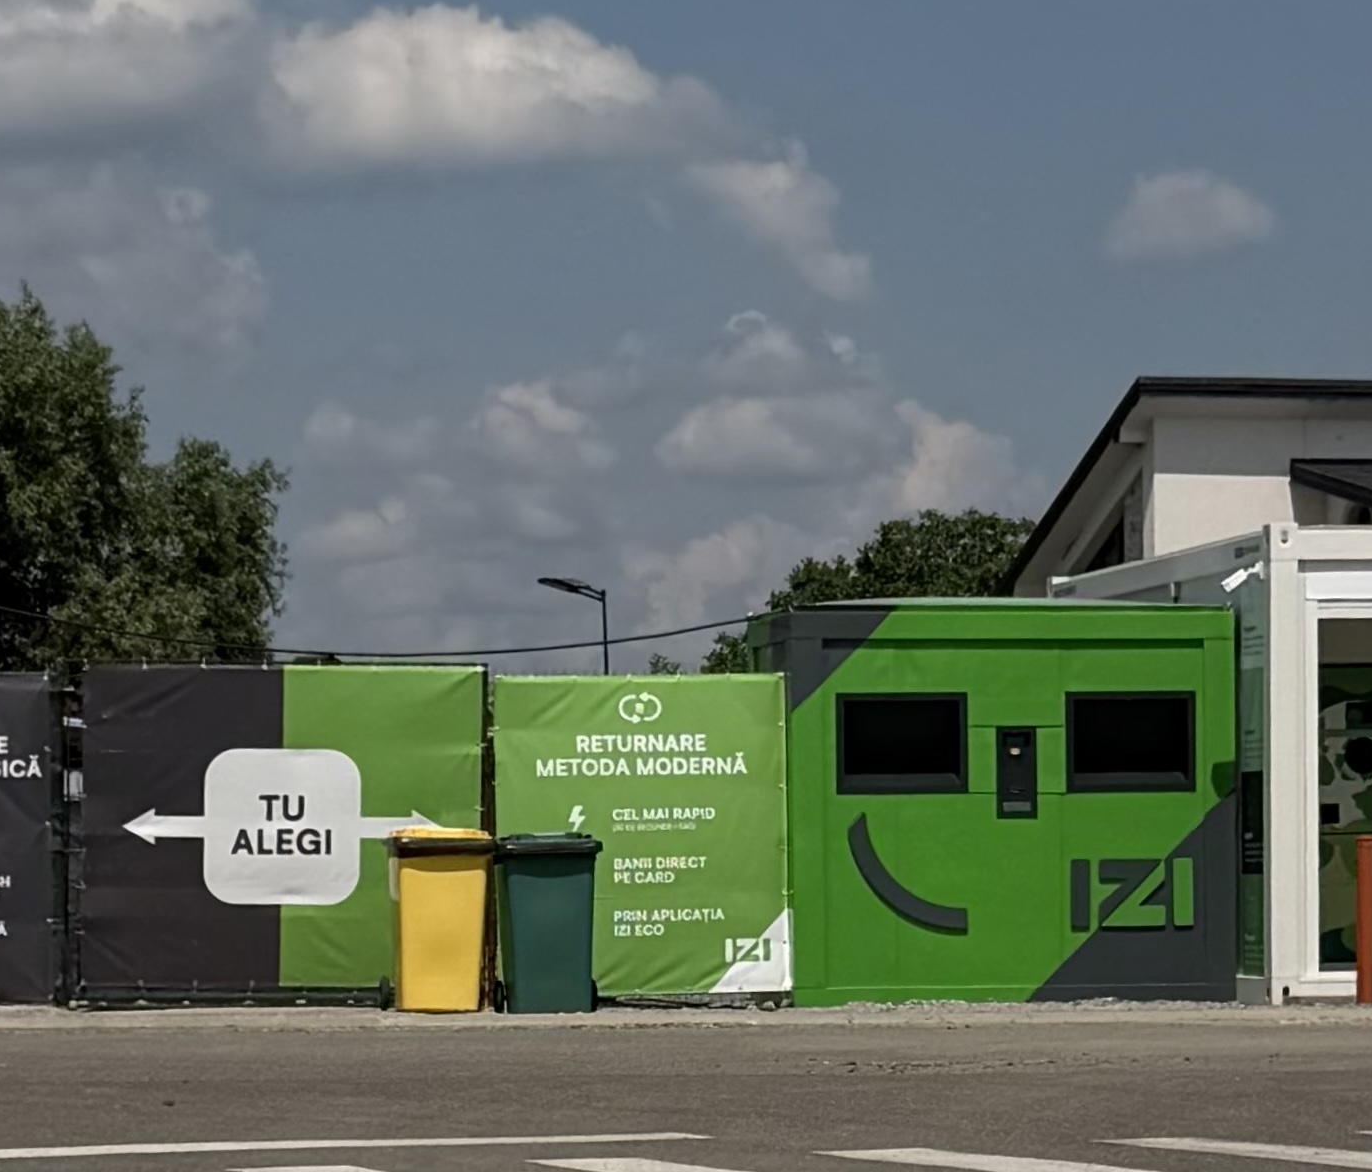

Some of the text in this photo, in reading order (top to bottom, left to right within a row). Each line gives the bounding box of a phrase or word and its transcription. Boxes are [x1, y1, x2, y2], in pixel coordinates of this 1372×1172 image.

[576, 734, 706, 753] RETURNARE
[536, 752, 747, 777] METODA MODERNĂ
[259, 794, 305, 821] TU
[612, 807, 716, 821] CEL MAI RAPID
[231, 828, 332, 855] ALEGI
[614, 856, 707, 870] BANII DIRECT
[614, 871, 675, 883] PE CARD
[1071, 858, 1195, 932] IZI
[614, 908, 725, 923] PRIN APLICAȚIA
[614, 925, 665, 937] IZI ECO
[725, 938, 771, 963] IZI
